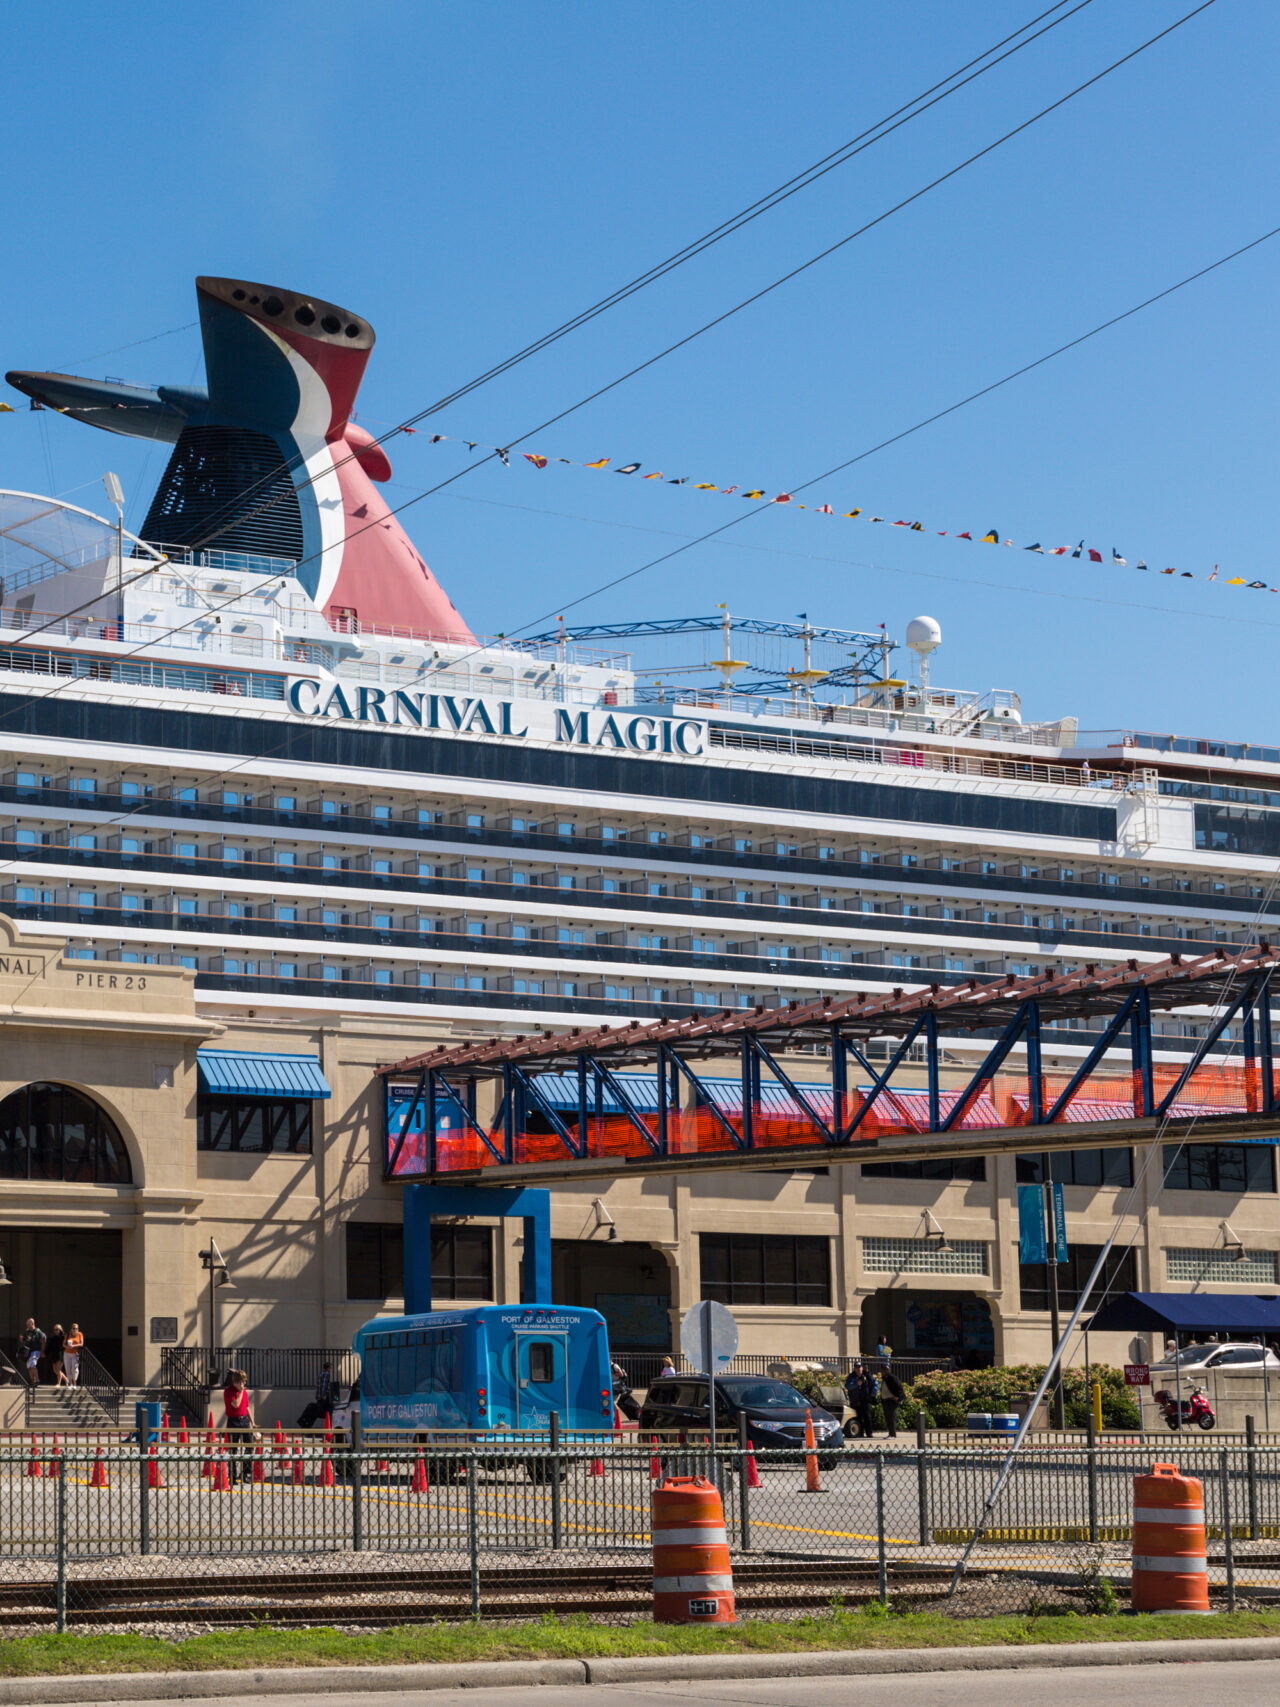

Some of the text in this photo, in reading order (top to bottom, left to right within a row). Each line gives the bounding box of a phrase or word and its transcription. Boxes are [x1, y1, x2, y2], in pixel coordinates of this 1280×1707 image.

[287, 679, 703, 756] CARNIVAL MAGIC
[76, 973, 146, 990] PIER 23
[536, 1316, 580, 1324] GALVESTON
[1131, 1375, 1145, 1383] WAY
